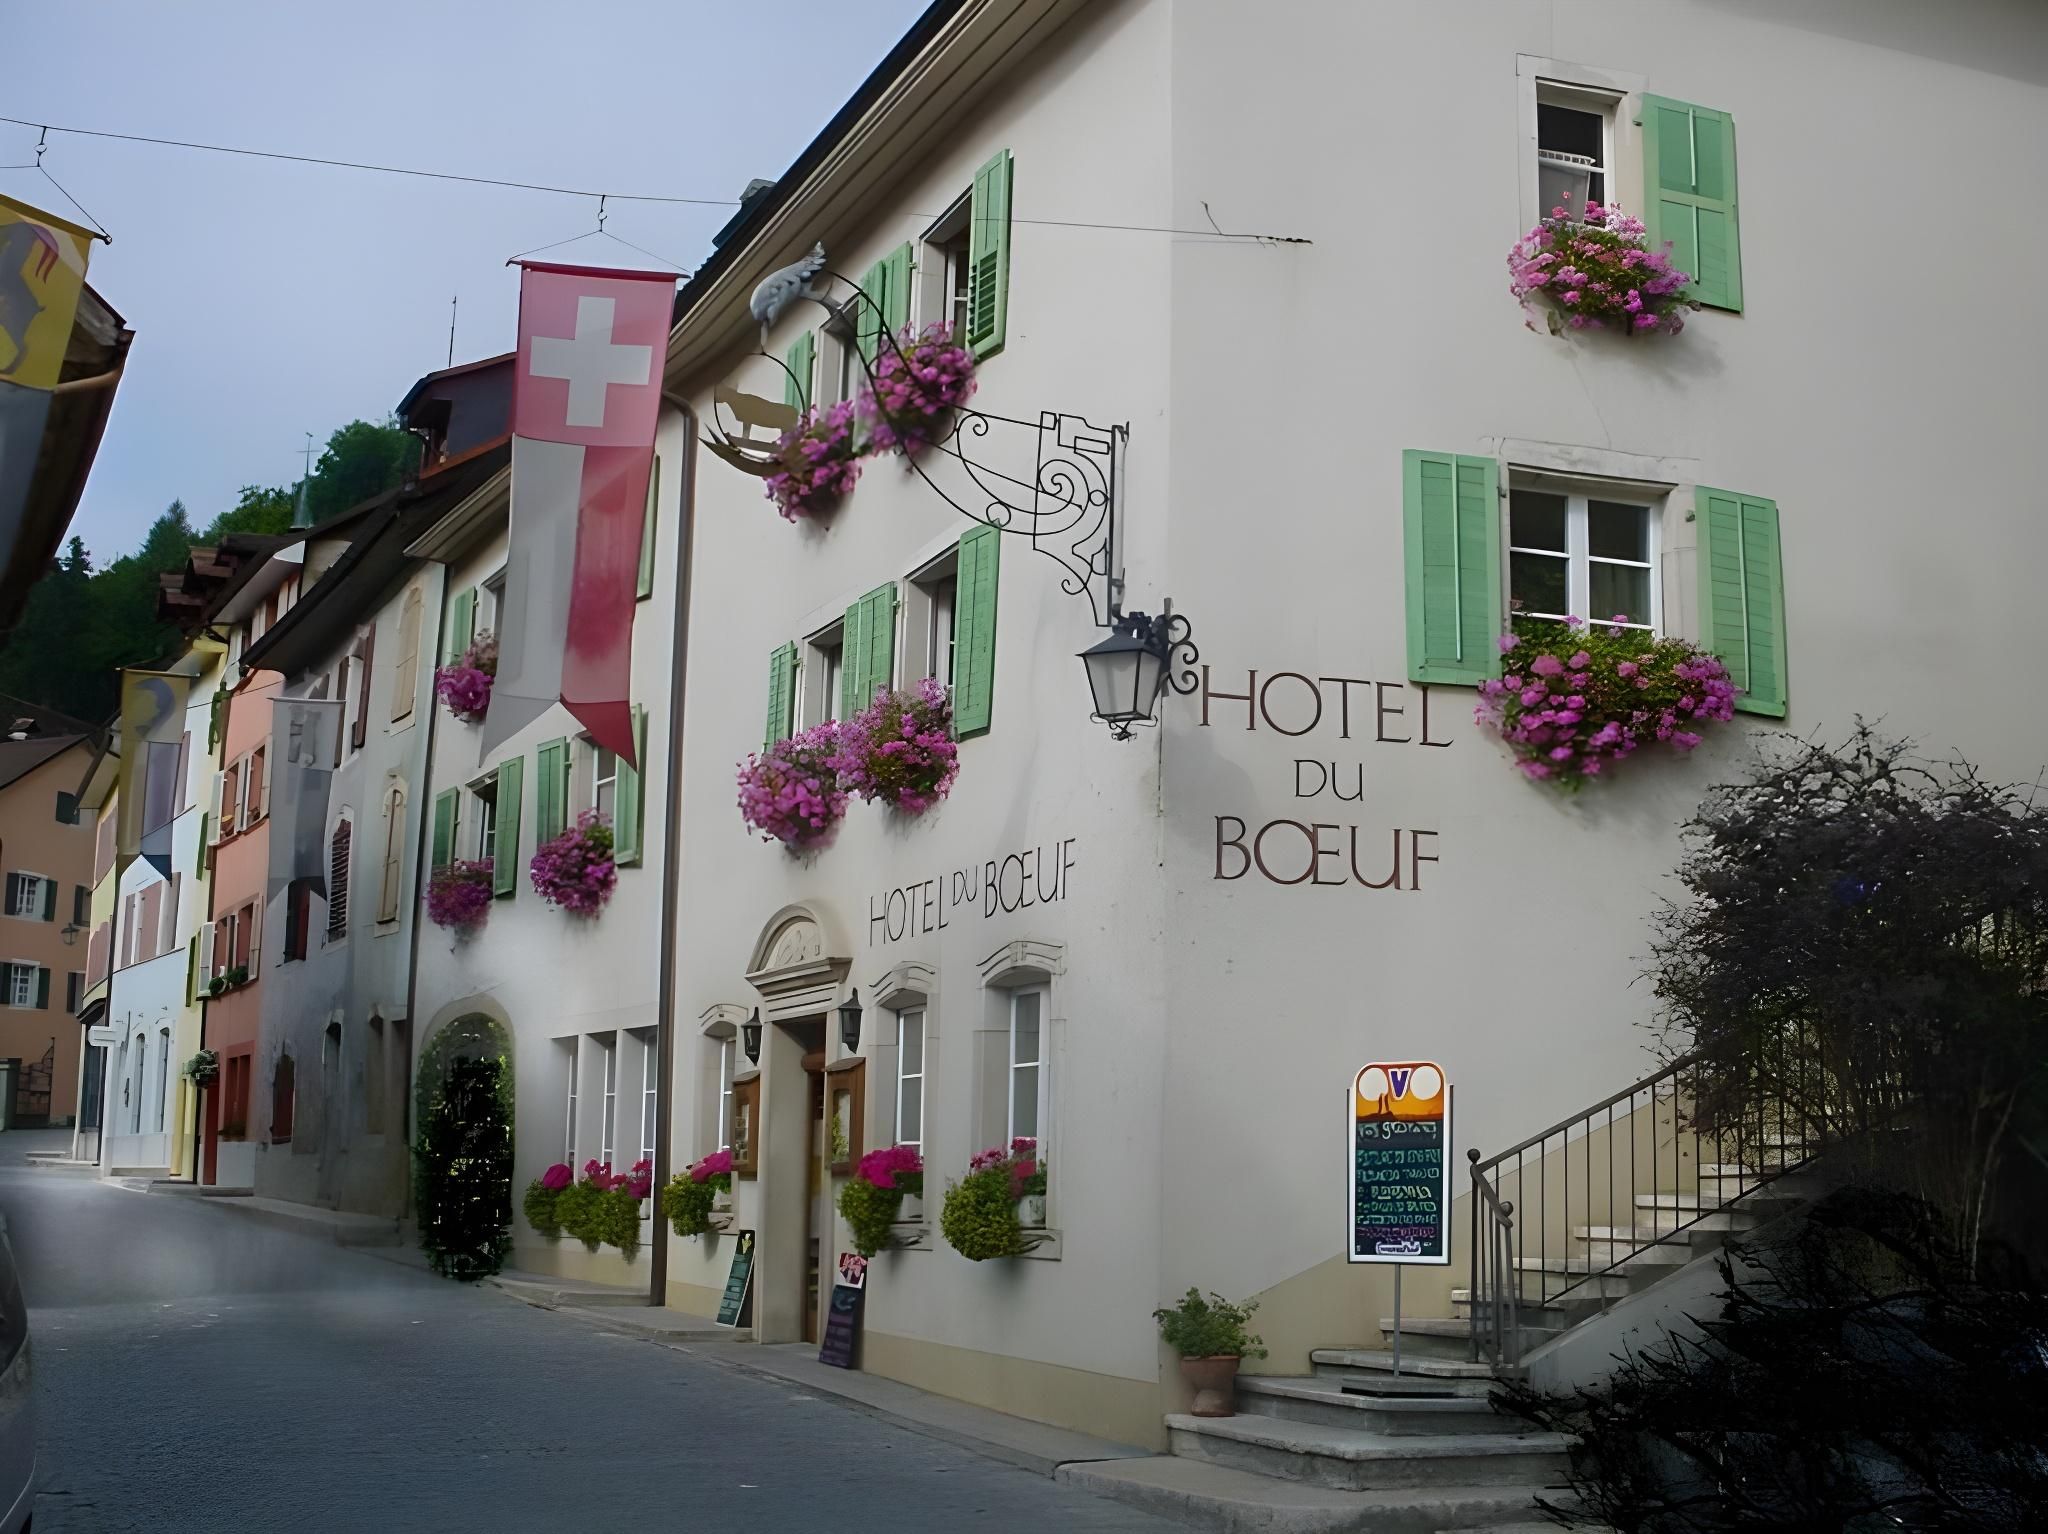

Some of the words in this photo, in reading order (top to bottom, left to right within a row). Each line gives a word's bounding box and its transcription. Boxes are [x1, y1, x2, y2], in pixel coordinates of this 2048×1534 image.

[1198, 664, 1454, 747] HOTEL
[1294, 759, 1363, 801] DU
[869, 875, 949, 947] HOTEL
[952, 865, 978, 907] DU
[984, 838, 1076, 919] BŒUF
[1213, 815, 1439, 891] BŒUF
